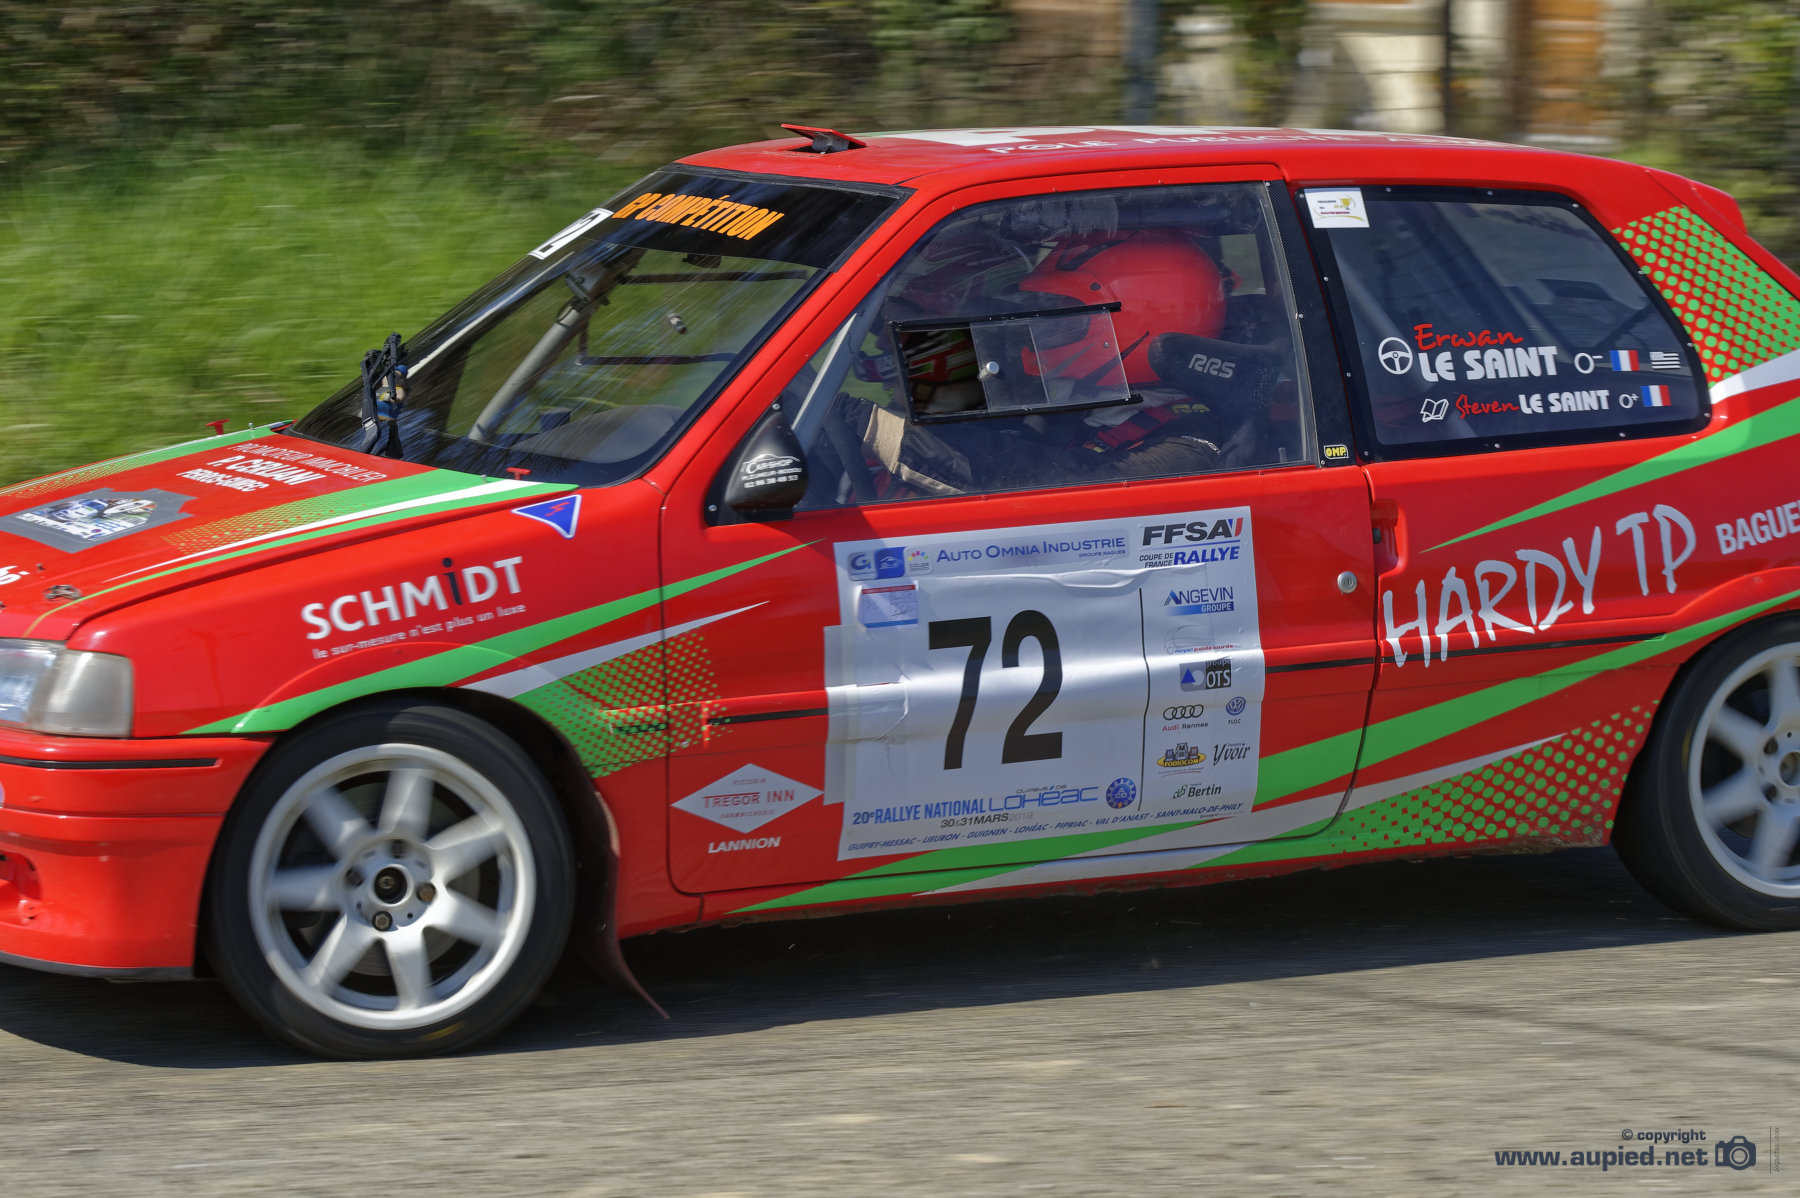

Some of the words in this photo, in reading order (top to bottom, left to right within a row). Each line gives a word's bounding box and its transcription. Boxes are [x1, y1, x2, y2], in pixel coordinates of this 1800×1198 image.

[635, 193, 785, 241] COMPÉTITION
[1414, 323, 1524, 350] Erwan
[1188, 353, 1236, 379] RRS
[1418, 351, 1456, 382] LE
[1463, 346, 1558, 380] SAINT
[1455, 394, 1520, 419] Steven
[1519, 394, 1543, 415] LE
[1548, 390, 1611, 413] SAINT
[1325, 446, 1347, 458] OMP
[1142, 519, 1234, 546] FFSA
[1715, 500, 1800, 555] BAGUE
[937, 549, 982, 563] AUTO
[986, 545, 1038, 559] OMNIA
[1043, 537, 1126, 553] INDUSTRIE
[1140, 553, 1163, 562] COUPE
[1165, 552, 1174, 560] DE
[1173, 546, 1240, 566] RALLYE
[1164, 586, 1234, 606] ANGEVIN
[1383, 525, 1602, 668] HARDY
[1615, 503, 1697, 597] TP
[1201, 602, 1232, 614] GROUPE
[312, 648, 328, 659] le
[332, 630, 407, 655] sur-mesure
[408, 623, 443, 638] n'est
[445, 615, 475, 632] plus
[477, 611, 494, 622] un
[496, 604, 527, 617] luxe
[928, 610, 1063, 770] 72
[1206, 670, 1231, 688] OTS
[767, 790, 795, 802] INN
[1188, 784, 1222, 798] Bertin
[874, 805, 921, 824] RALLYE
[924, 798, 984, 819] NATIONAL
[707, 836, 782, 854] LANNION
